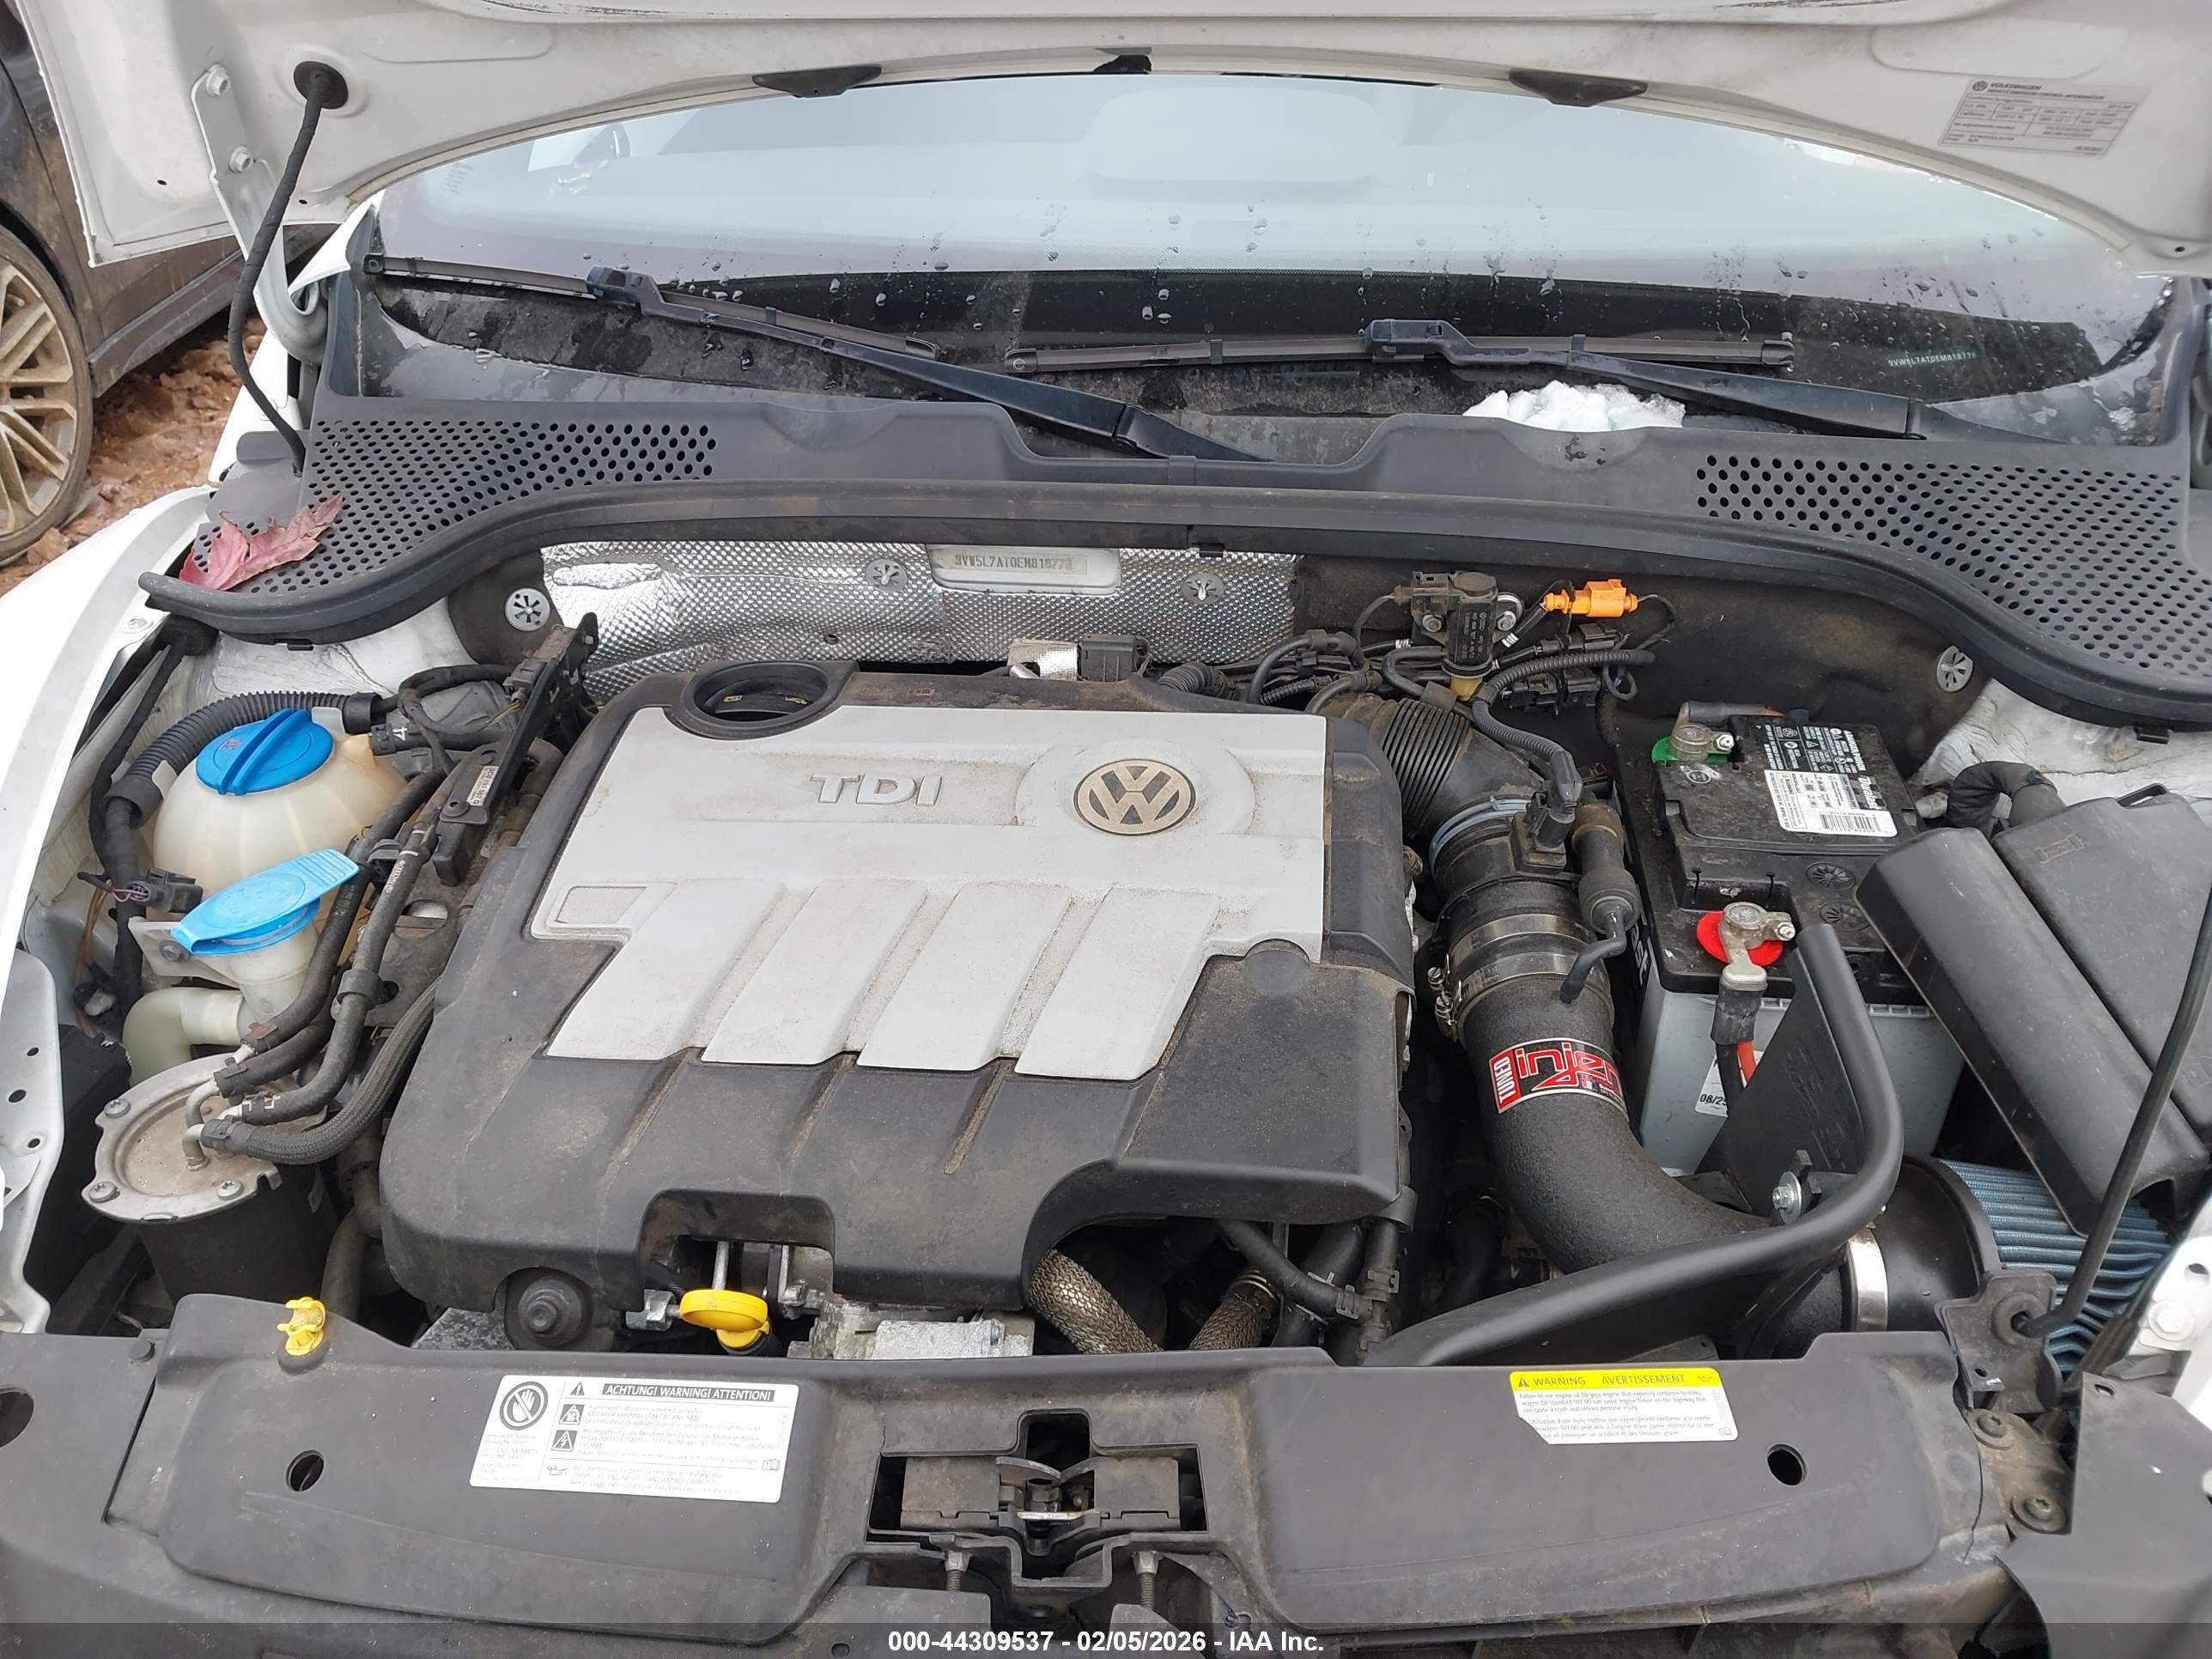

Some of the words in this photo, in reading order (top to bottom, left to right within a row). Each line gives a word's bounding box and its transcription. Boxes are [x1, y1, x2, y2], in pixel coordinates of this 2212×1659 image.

[811, 773, 942, 807] TDI
[1533, 1376, 1586, 1387] WARNING
[1601, 1375, 1686, 1385] AVERTISSEMENT
